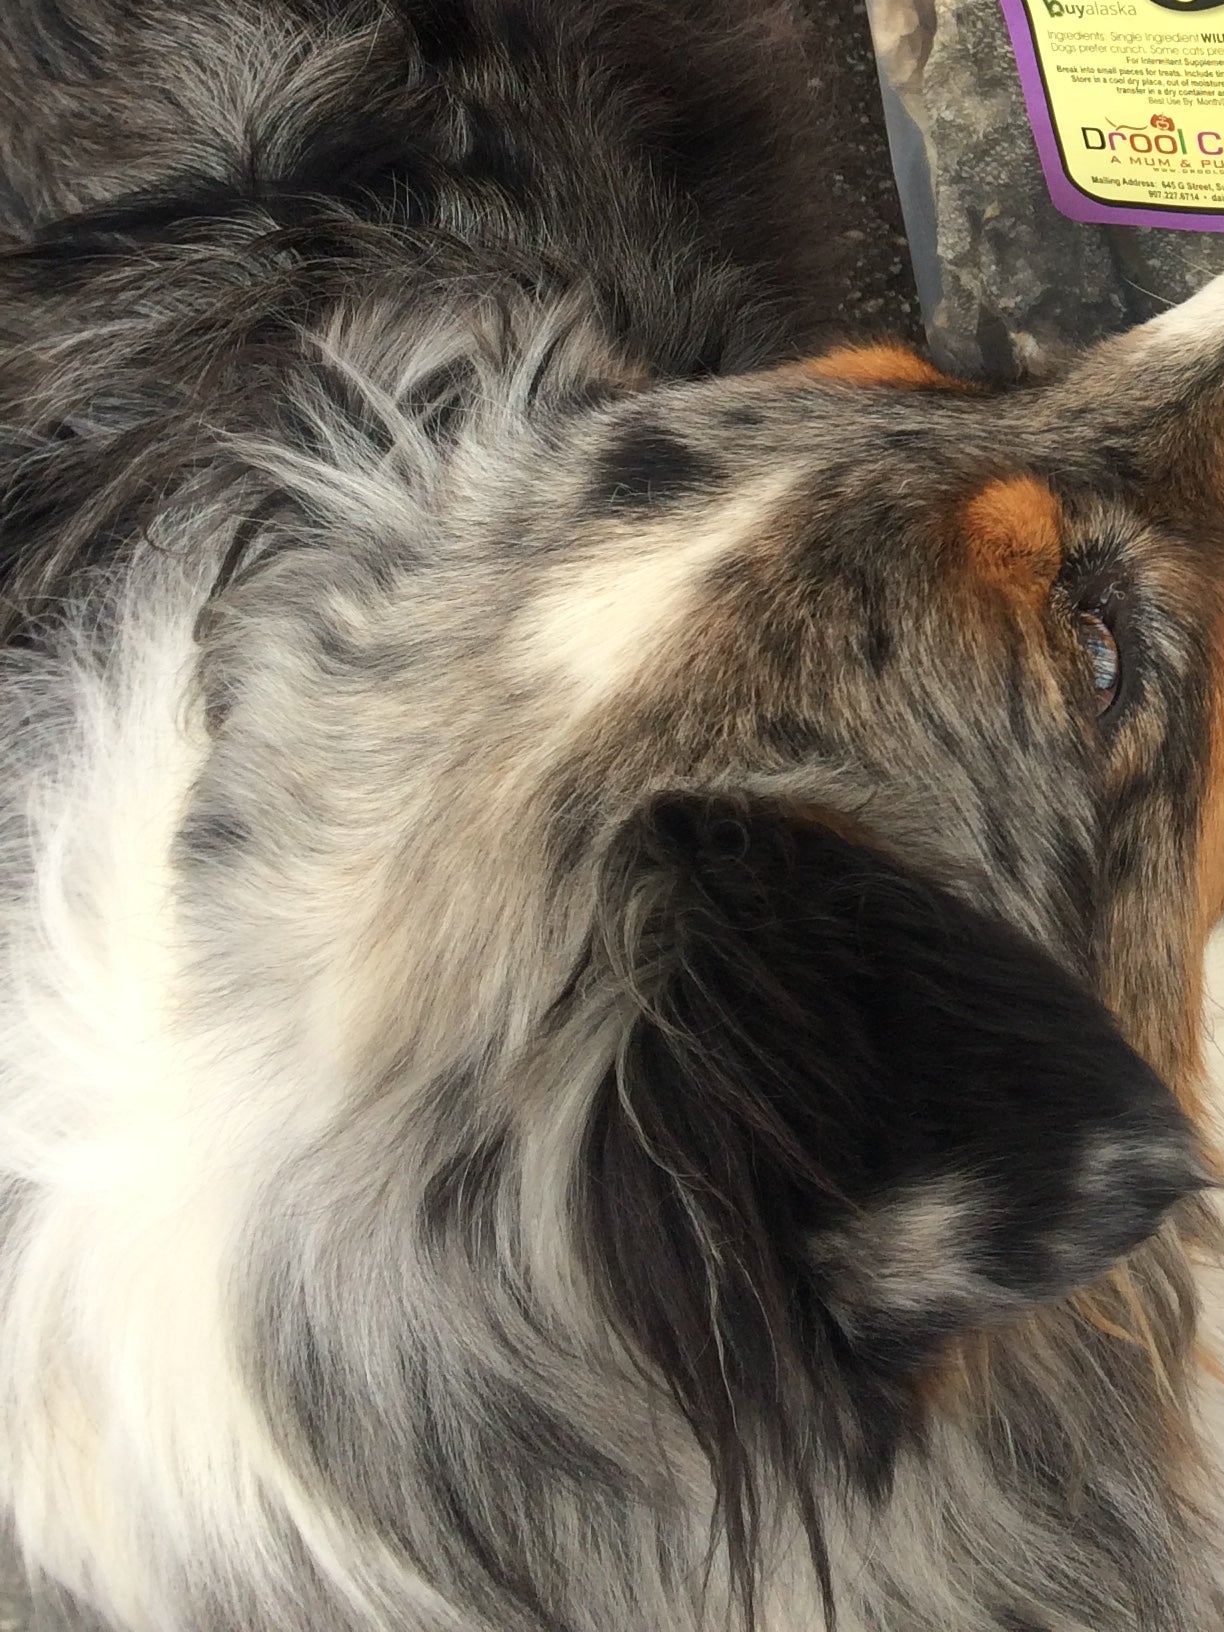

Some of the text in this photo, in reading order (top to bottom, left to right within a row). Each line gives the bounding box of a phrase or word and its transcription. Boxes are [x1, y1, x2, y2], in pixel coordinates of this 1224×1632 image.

[1048, 30, 1104, 42] Ingredients:
[1110, 32, 1142, 43] Single
[1145, 33, 1199, 43] Ingredient
[1051, 43, 1076, 54] Dogs
[1078, 44, 1107, 54] prefer
[1110, 44, 1147, 54] crunch.
[1151, 46, 1179, 55] Some
[1183, 46, 1204, 55] cats
[1126, 56, 1139, 64] For
[1057, 65, 1078, 73] Break
[1146, 68, 1157, 76] for
[1184, 69, 1213, 77] Include
[1071, 75, 1092, 83] Store
[1127, 78, 1139, 87] dry
[1164, 88, 1176, 97] dry
[1081, 126, 1187, 154] Drool
[1110, 156, 1121, 164] A
[1130, 157, 1171, 167] MUM
[1180, 160, 1191, 168] &
[1092, 176, 1120, 186] Mailing
[1122, 178, 1157, 187] Address:
[1178, 182, 1185, 190] G
[1187, 182, 1214, 191] Street,
